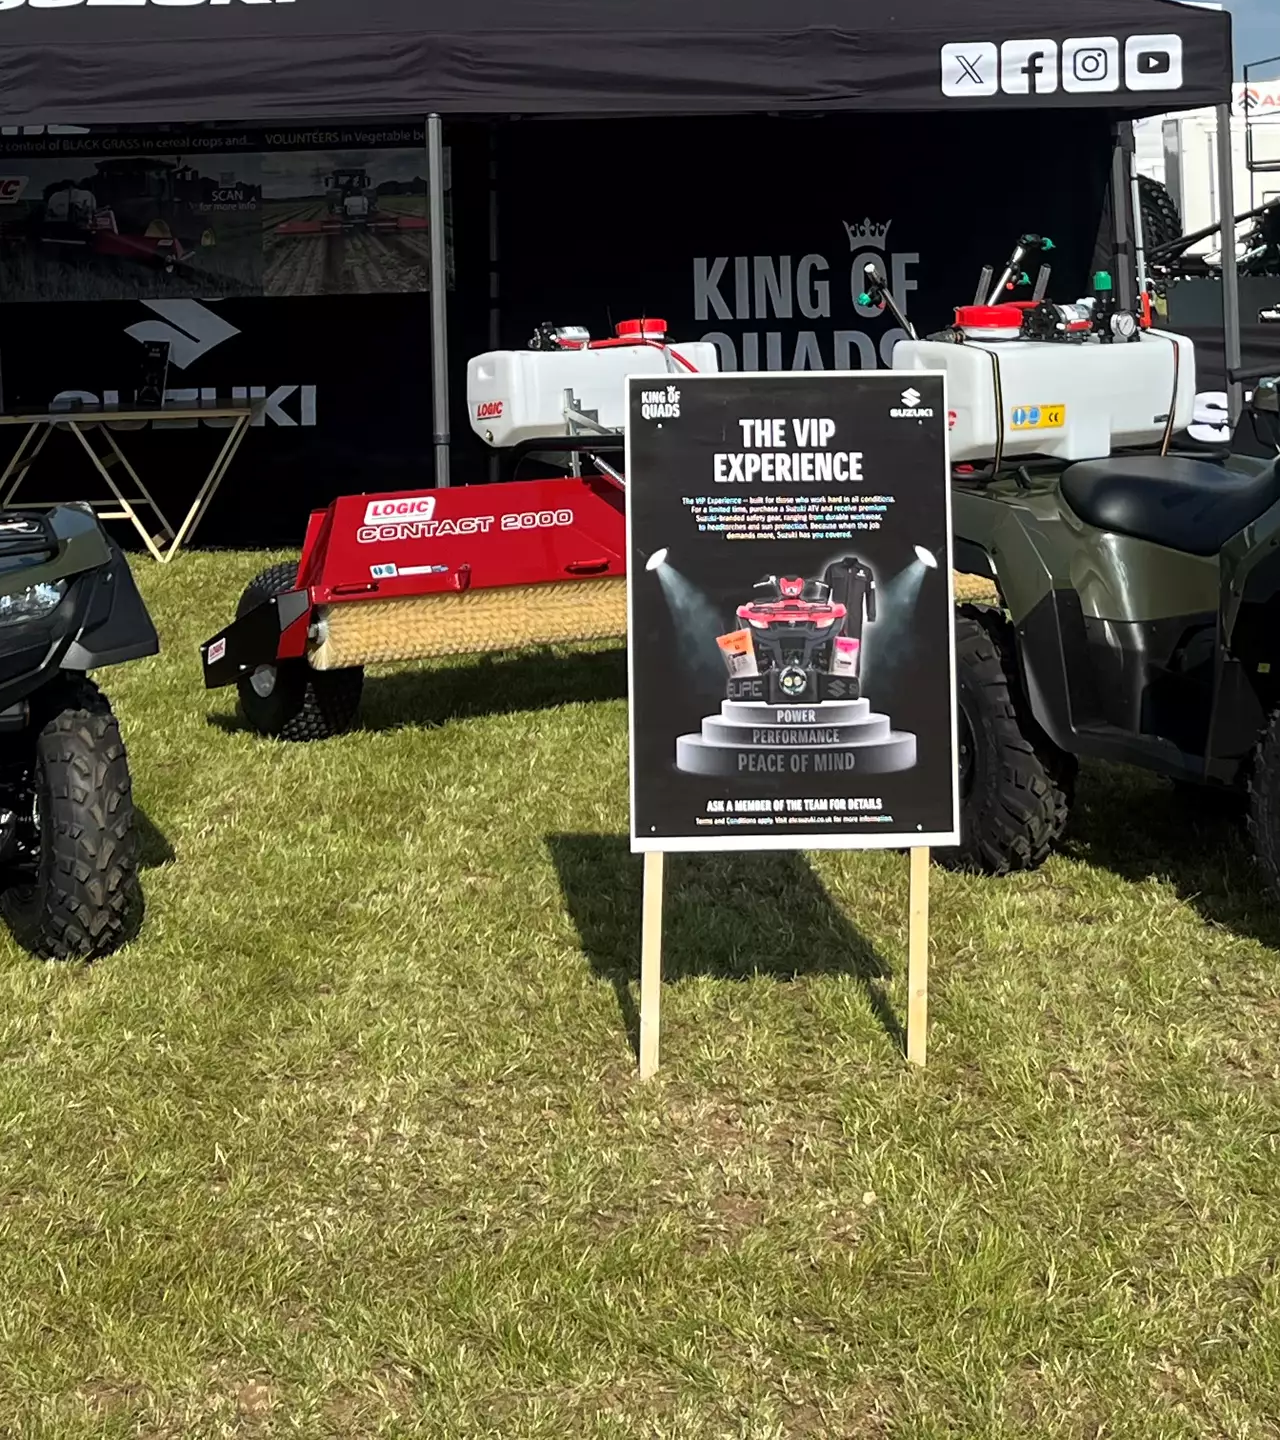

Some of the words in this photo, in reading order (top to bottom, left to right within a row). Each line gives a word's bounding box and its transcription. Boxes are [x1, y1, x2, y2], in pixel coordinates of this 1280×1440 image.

[62, 139, 100, 151] BLACK
[102, 138, 140, 150] GRASS
[264, 132, 339, 144] VOLUNTEERS
[353, 129, 411, 145] Vegetable
[212, 190, 243, 201] SCAN
[214, 203, 236, 211] more
[693, 254, 830, 321] KING
[851, 252, 920, 317] OF
[641, 391, 666, 403] KING
[667, 391, 681, 403] OF
[477, 401, 503, 417] LOGIC
[642, 404, 681, 419] QUADS
[890, 408, 933, 418] SUZUKI
[739, 419, 786, 448] THE
[793, 418, 837, 448] VIP
[713, 452, 864, 483] EXPERIENCE
[372, 500, 429, 516] LOGIC
[357, 517, 495, 543] CONTACT
[501, 509, 574, 531] 2000
[776, 710, 816, 722] POWER
[752, 728, 840, 743] PERFORMANCE
[738, 753, 786, 772] PEACE
[790, 754, 810, 772] OF
[814, 752, 856, 771] MIND
[706, 800, 725, 812] ASK
[726, 800, 734, 811] A
[734, 799, 772, 812] MEMBER
[773, 800, 785, 811] OF
[786, 799, 803, 811] THE
[804, 799, 828, 811] TEAM
[829, 799, 847, 810] FOR
[847, 798, 882, 810] DETAILS
